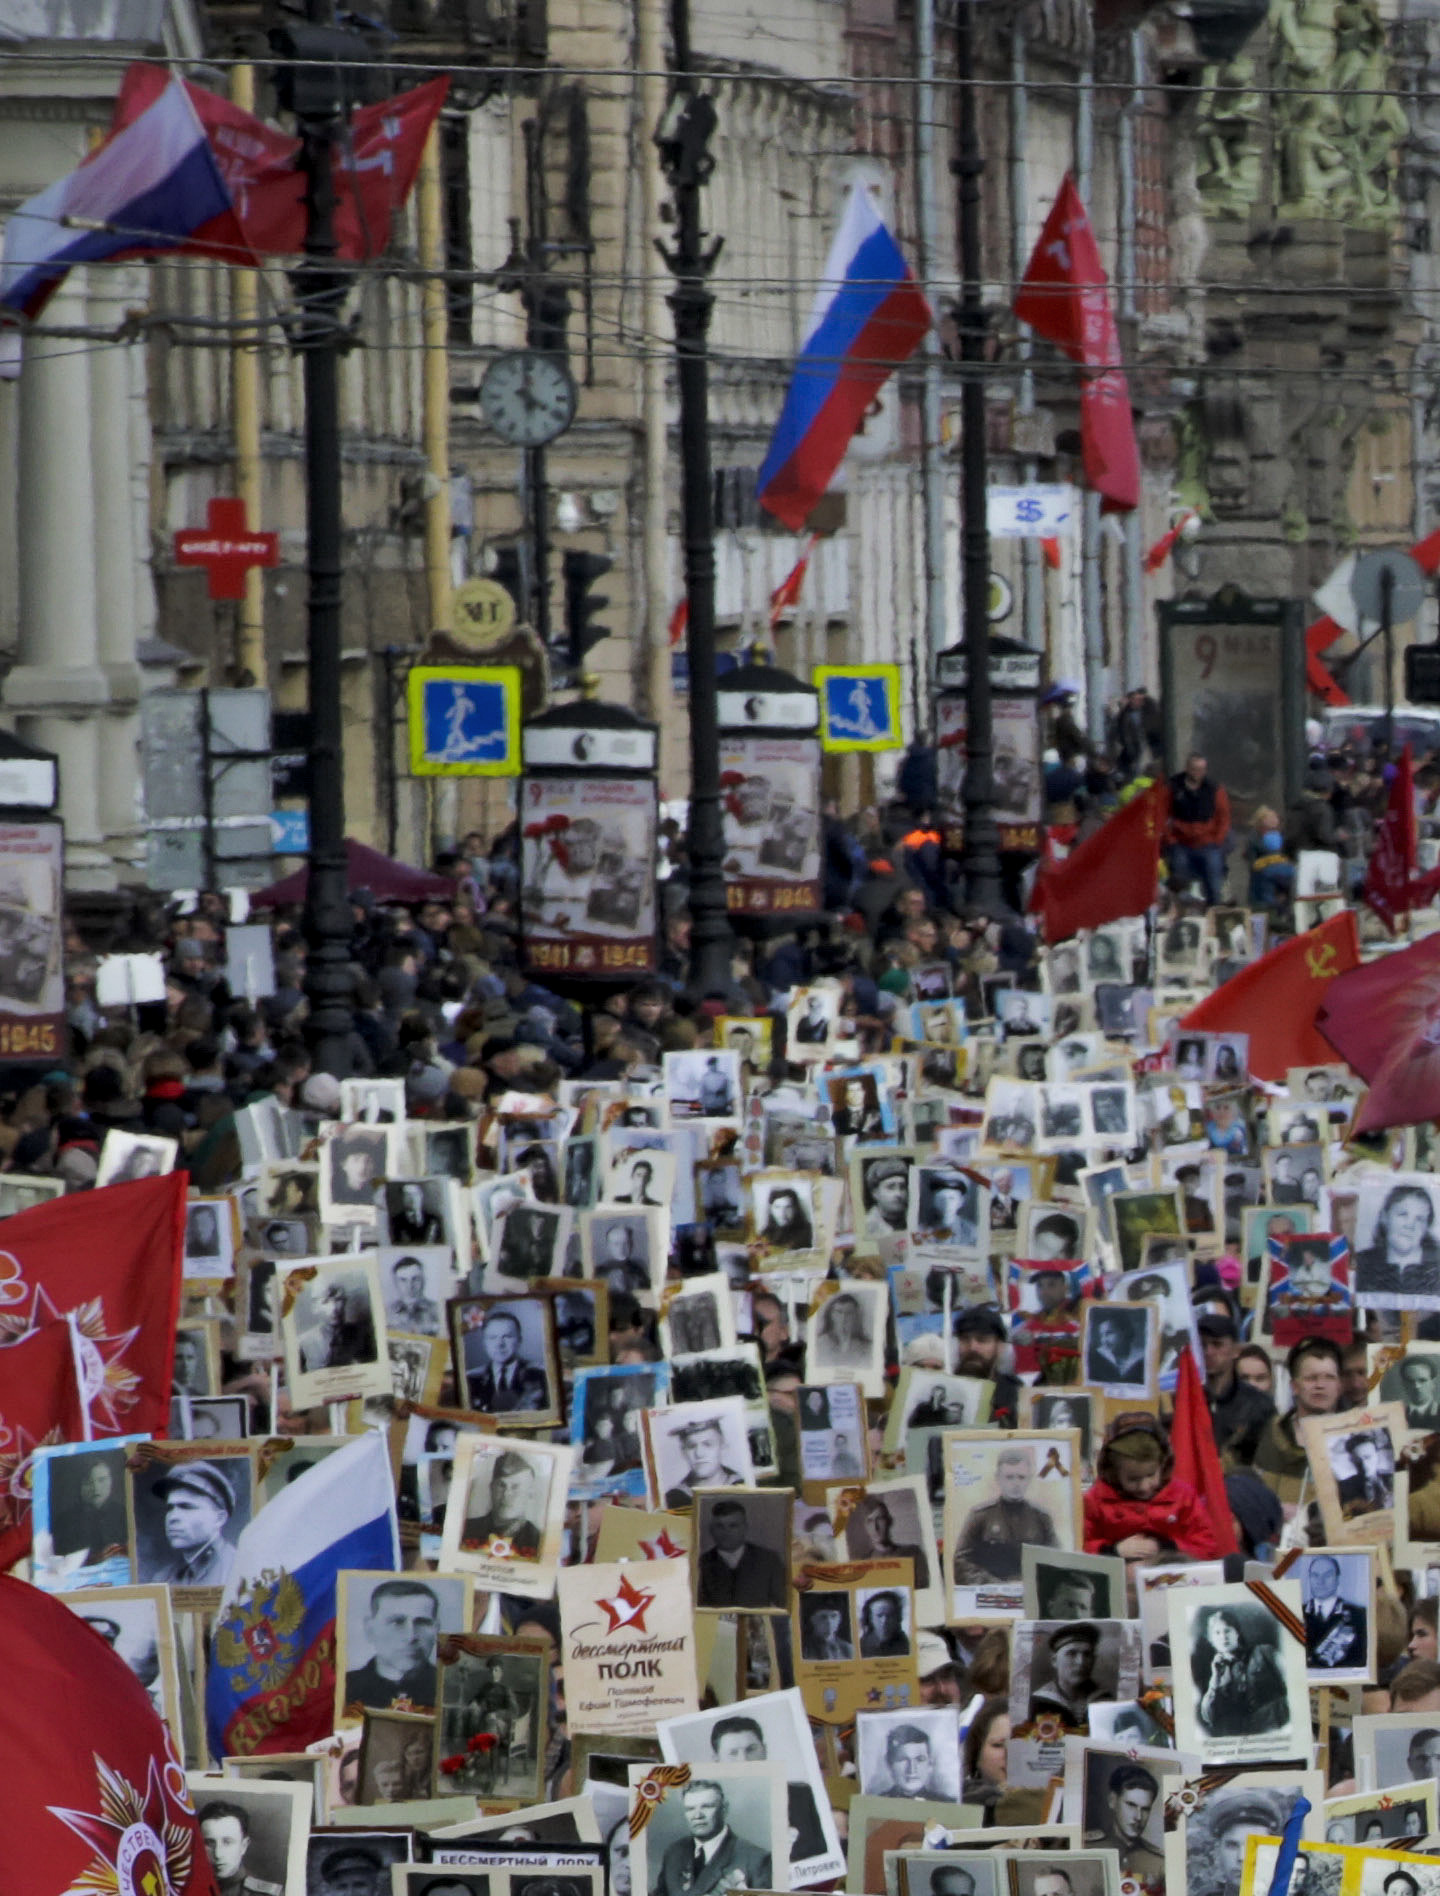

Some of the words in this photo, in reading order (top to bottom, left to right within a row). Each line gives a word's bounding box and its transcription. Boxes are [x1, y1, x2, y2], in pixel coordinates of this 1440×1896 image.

[1196, 636, 1217, 678] 9
[570, 1635, 687, 1662] бессмертный
[597, 1661, 663, 1680] ПОЛК
[439, 1855, 548, 1867] БЕССМЕРТНЫЙ
